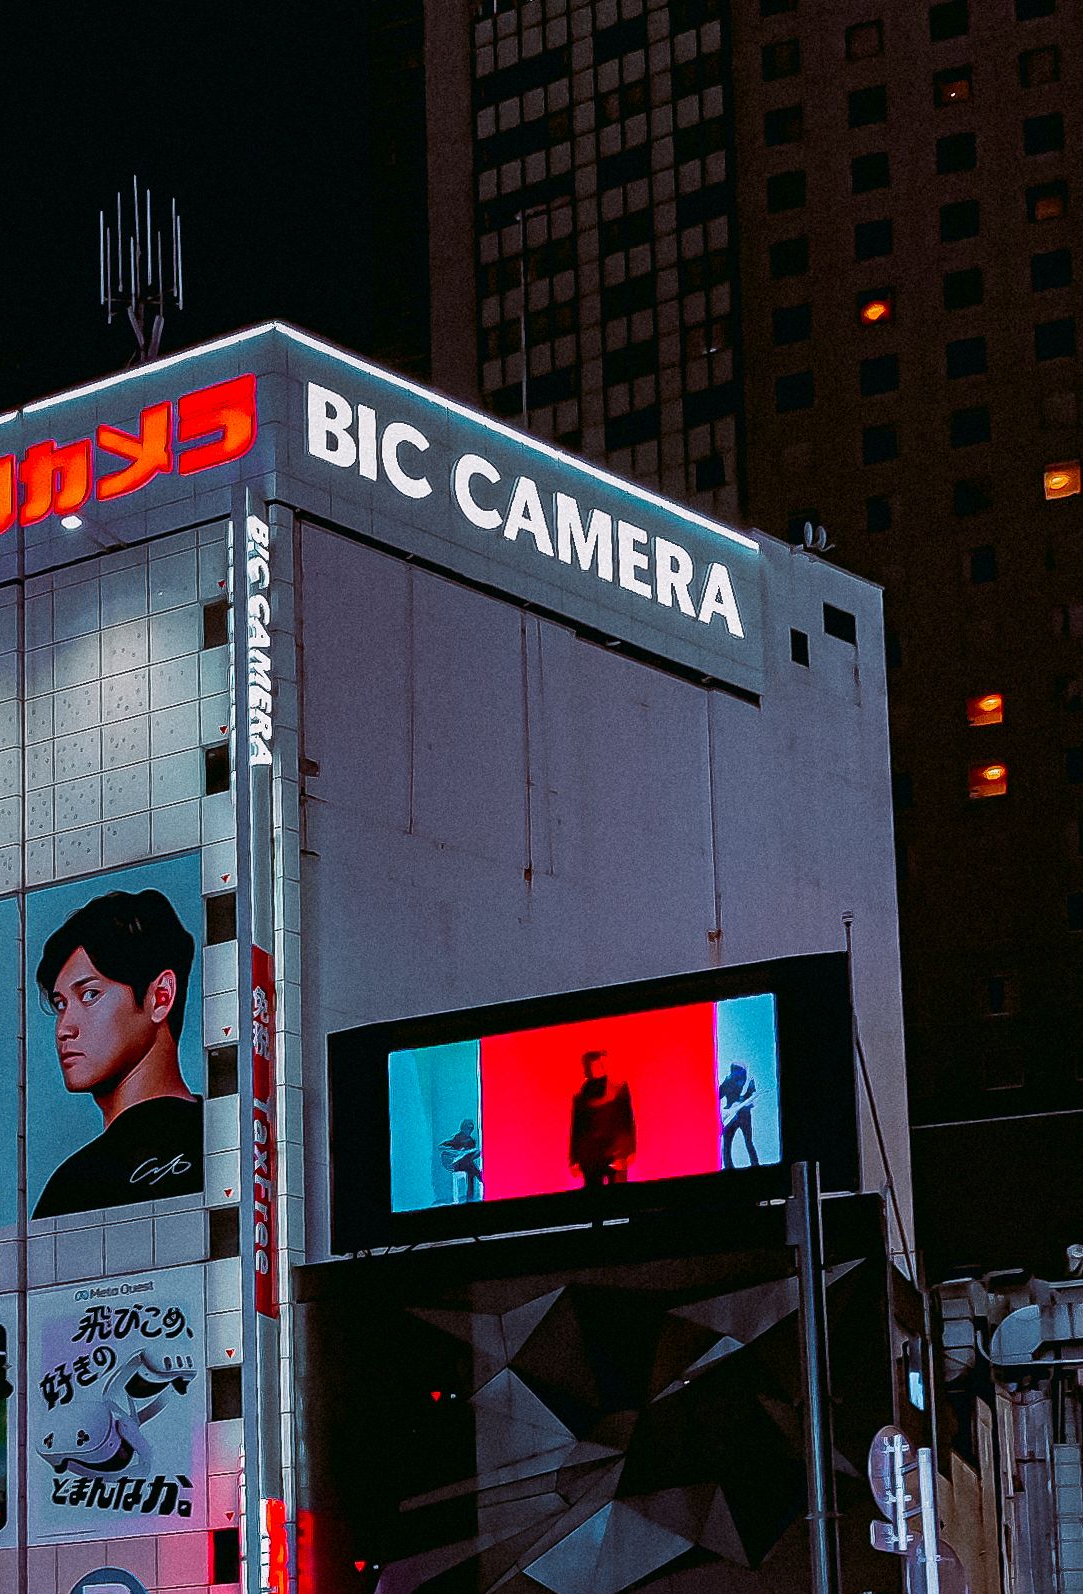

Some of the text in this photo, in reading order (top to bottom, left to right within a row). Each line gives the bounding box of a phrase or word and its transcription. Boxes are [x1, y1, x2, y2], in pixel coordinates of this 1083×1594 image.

[305, 381, 746, 639] BIC CAMERA
[247, 515, 273, 767] BIC CAMERA
[40, 1345, 116, 1411] 好きの
